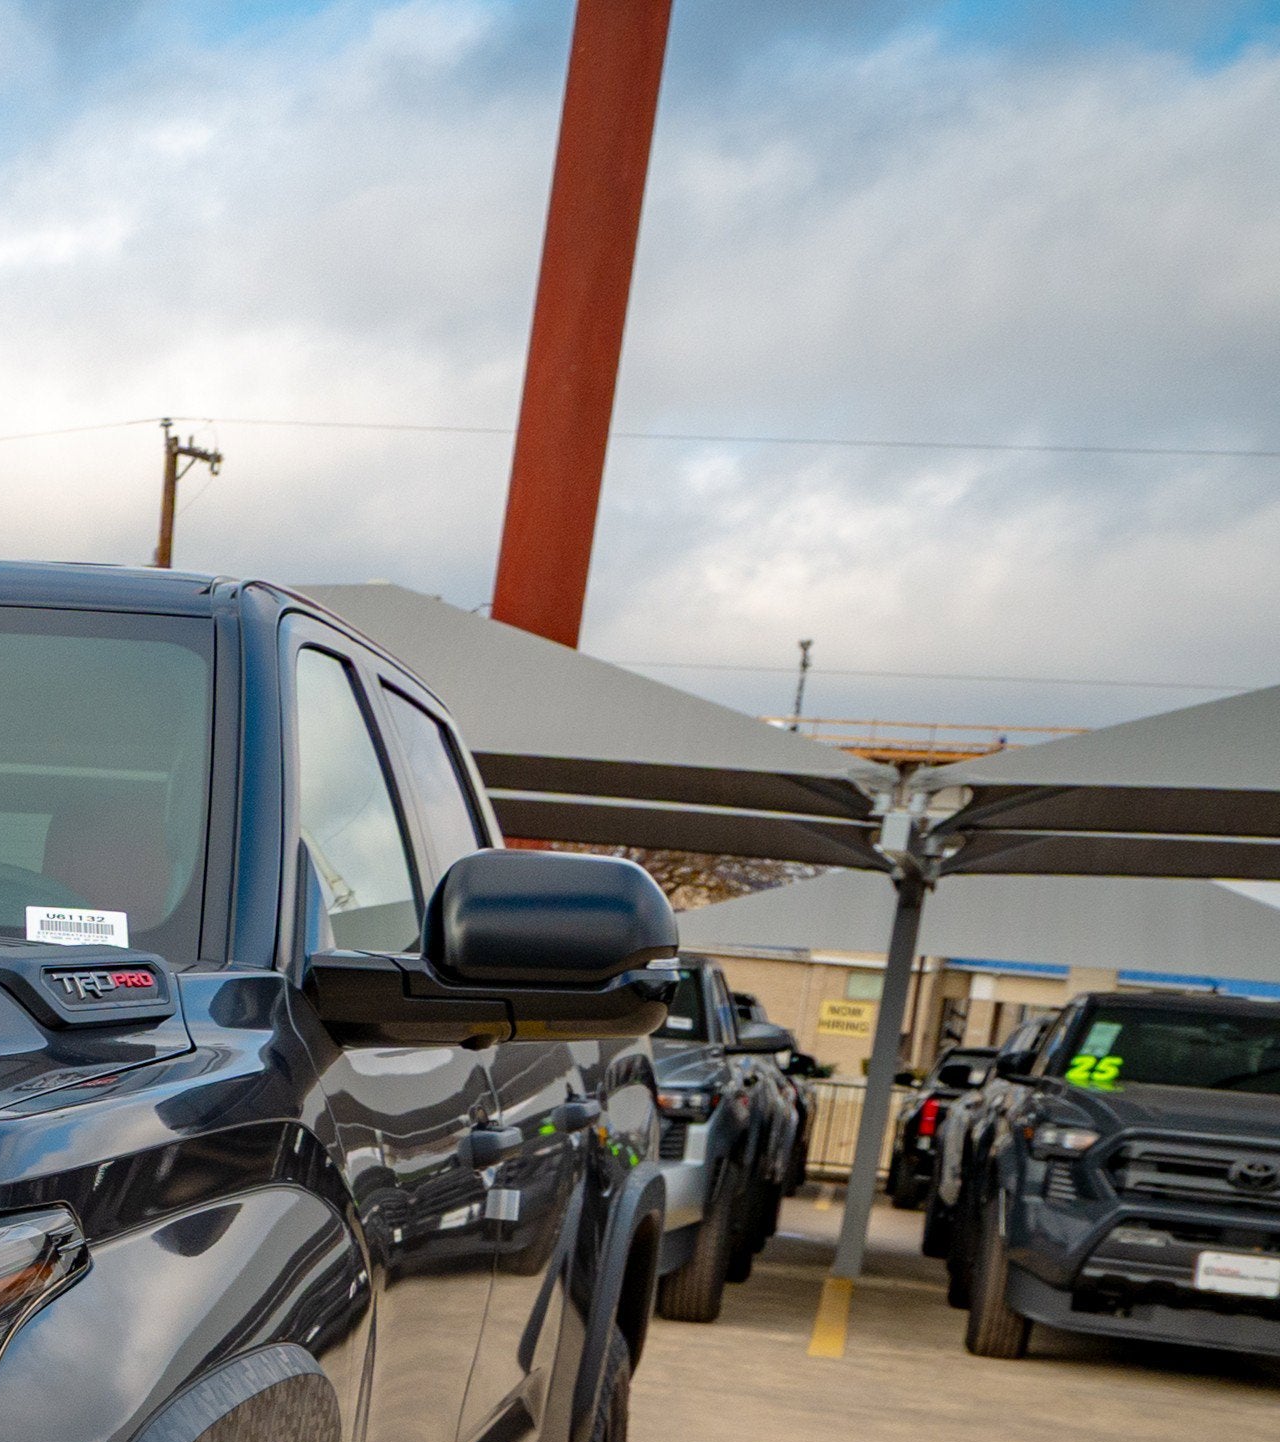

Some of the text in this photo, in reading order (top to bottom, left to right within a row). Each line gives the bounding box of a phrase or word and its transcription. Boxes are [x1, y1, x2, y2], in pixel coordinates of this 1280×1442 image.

[112, 971, 155, 988] PRO
[827, 1005, 865, 1017] NOW
[817, 1017, 870, 1033] HIRING
[1065, 1055, 1125, 1082] 25
